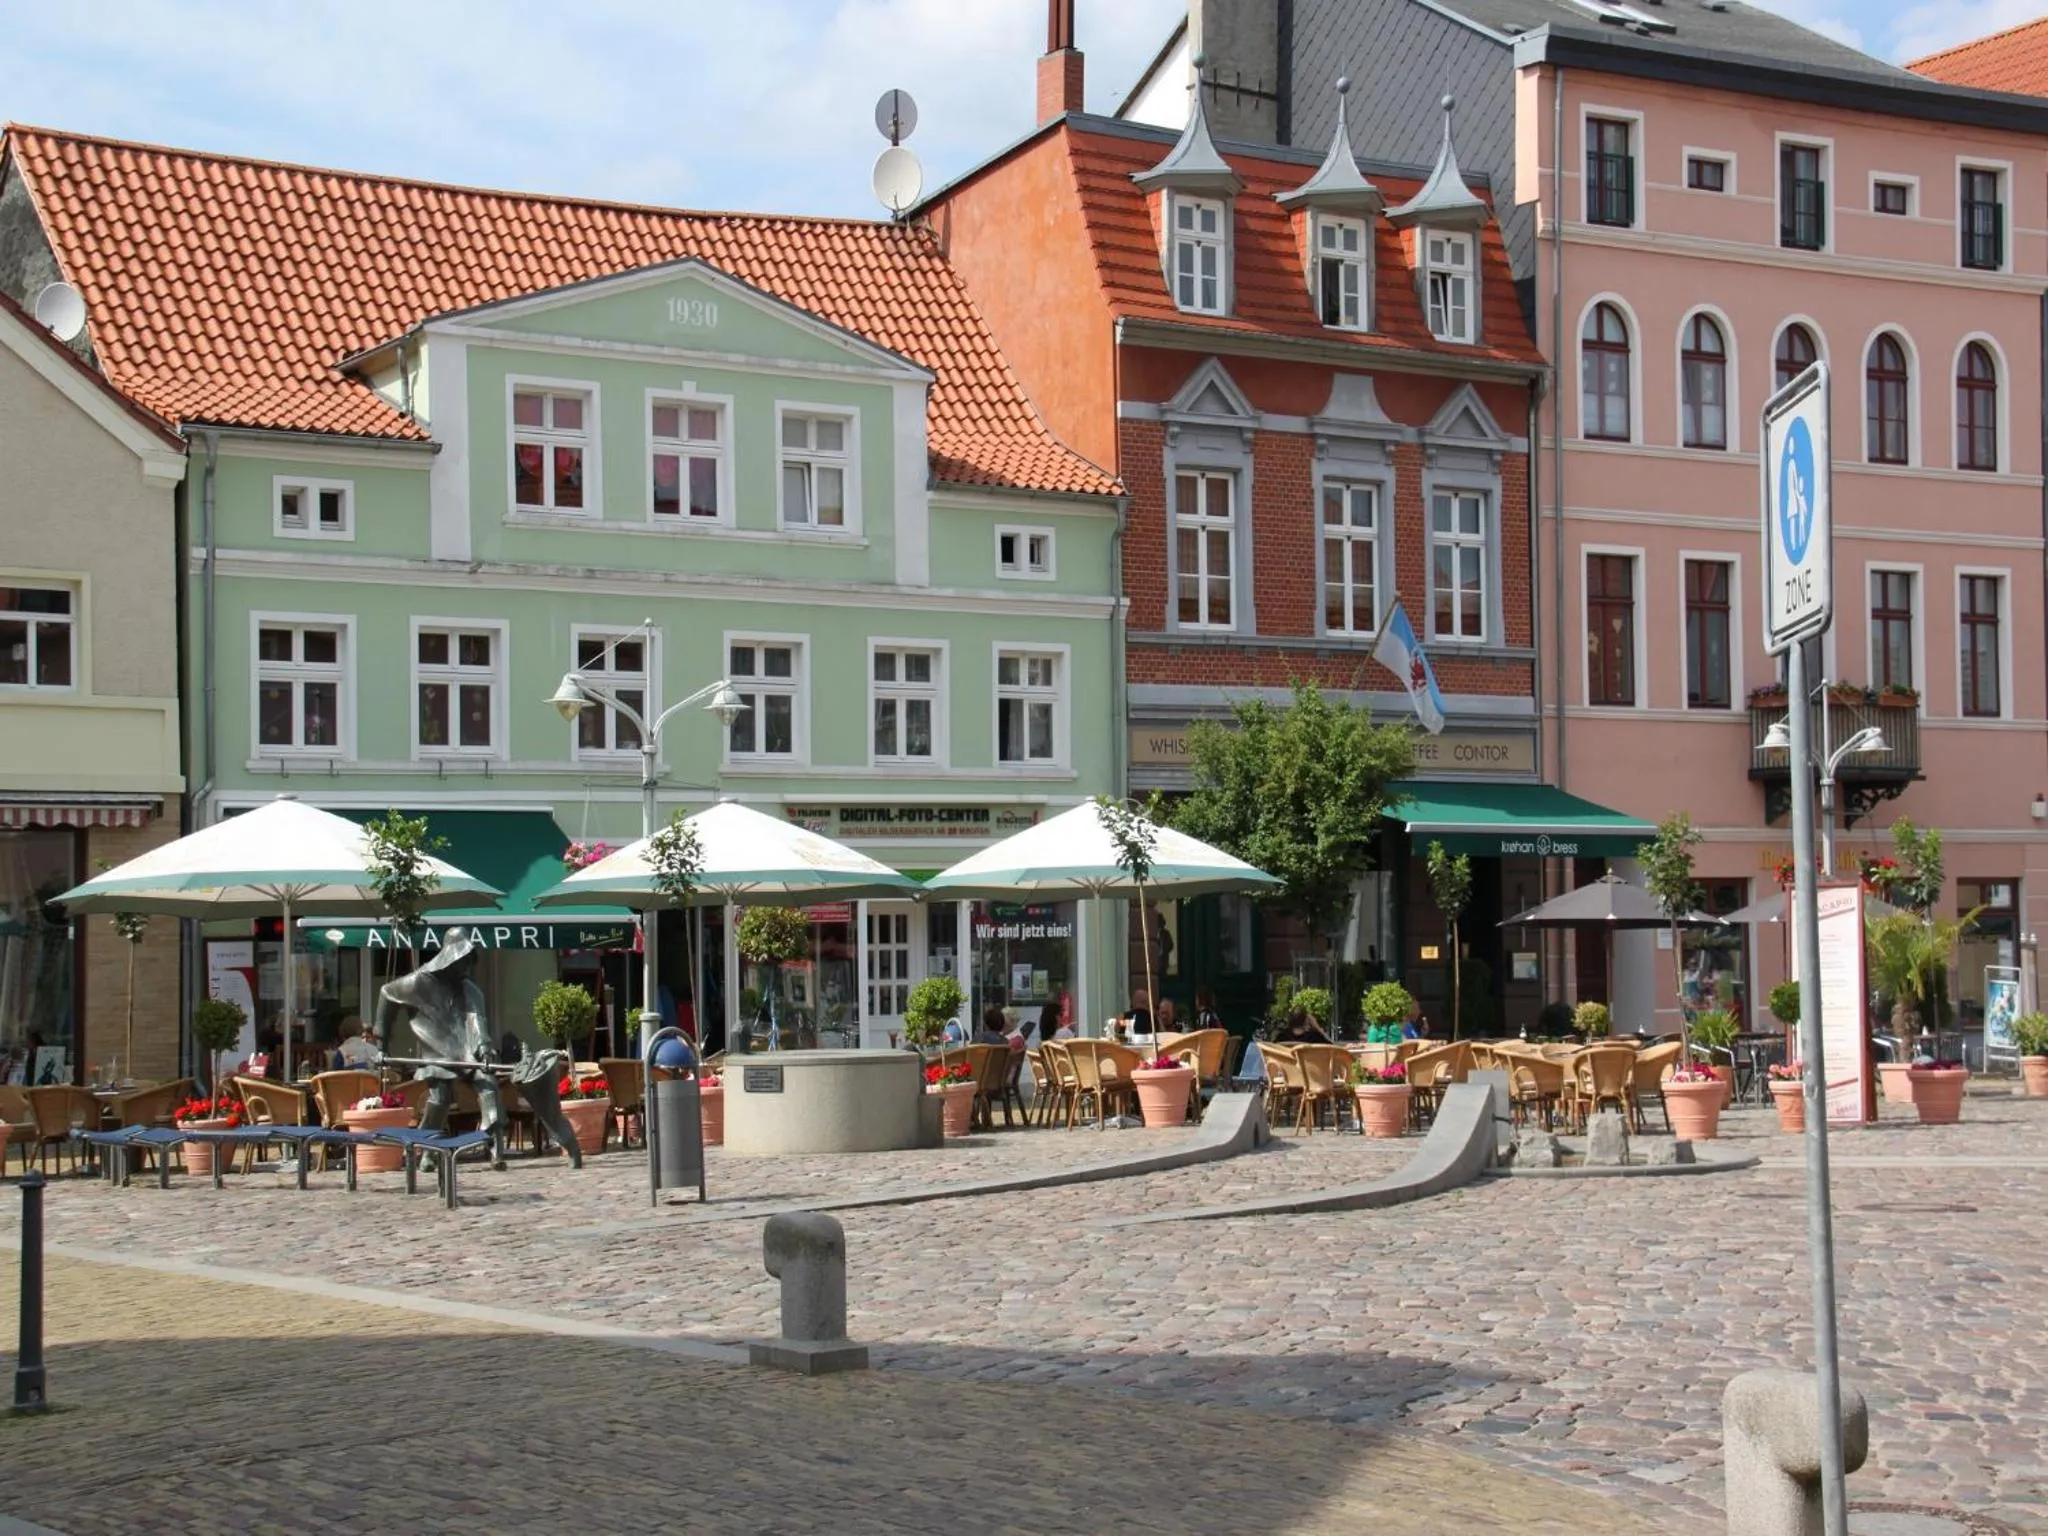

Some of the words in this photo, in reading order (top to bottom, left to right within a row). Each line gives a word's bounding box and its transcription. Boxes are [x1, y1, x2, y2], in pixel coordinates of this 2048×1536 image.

[666, 297, 718, 328] 1930
[1785, 569, 1812, 614] ZONE
[1149, 738, 1189, 755] WHIS
[1453, 744, 1509, 761] CONTOR
[839, 807, 990, 822] DIGITAL-FOTO-CENTER
[1553, 842, 1578, 854] bress
[366, 926, 555, 949] ANAAPRI
[976, 924, 995, 938] Wir
[998, 923, 1019, 937] sind
[1021, 923, 1044, 940] jetzt
[1047, 922, 1072, 937] eins!
